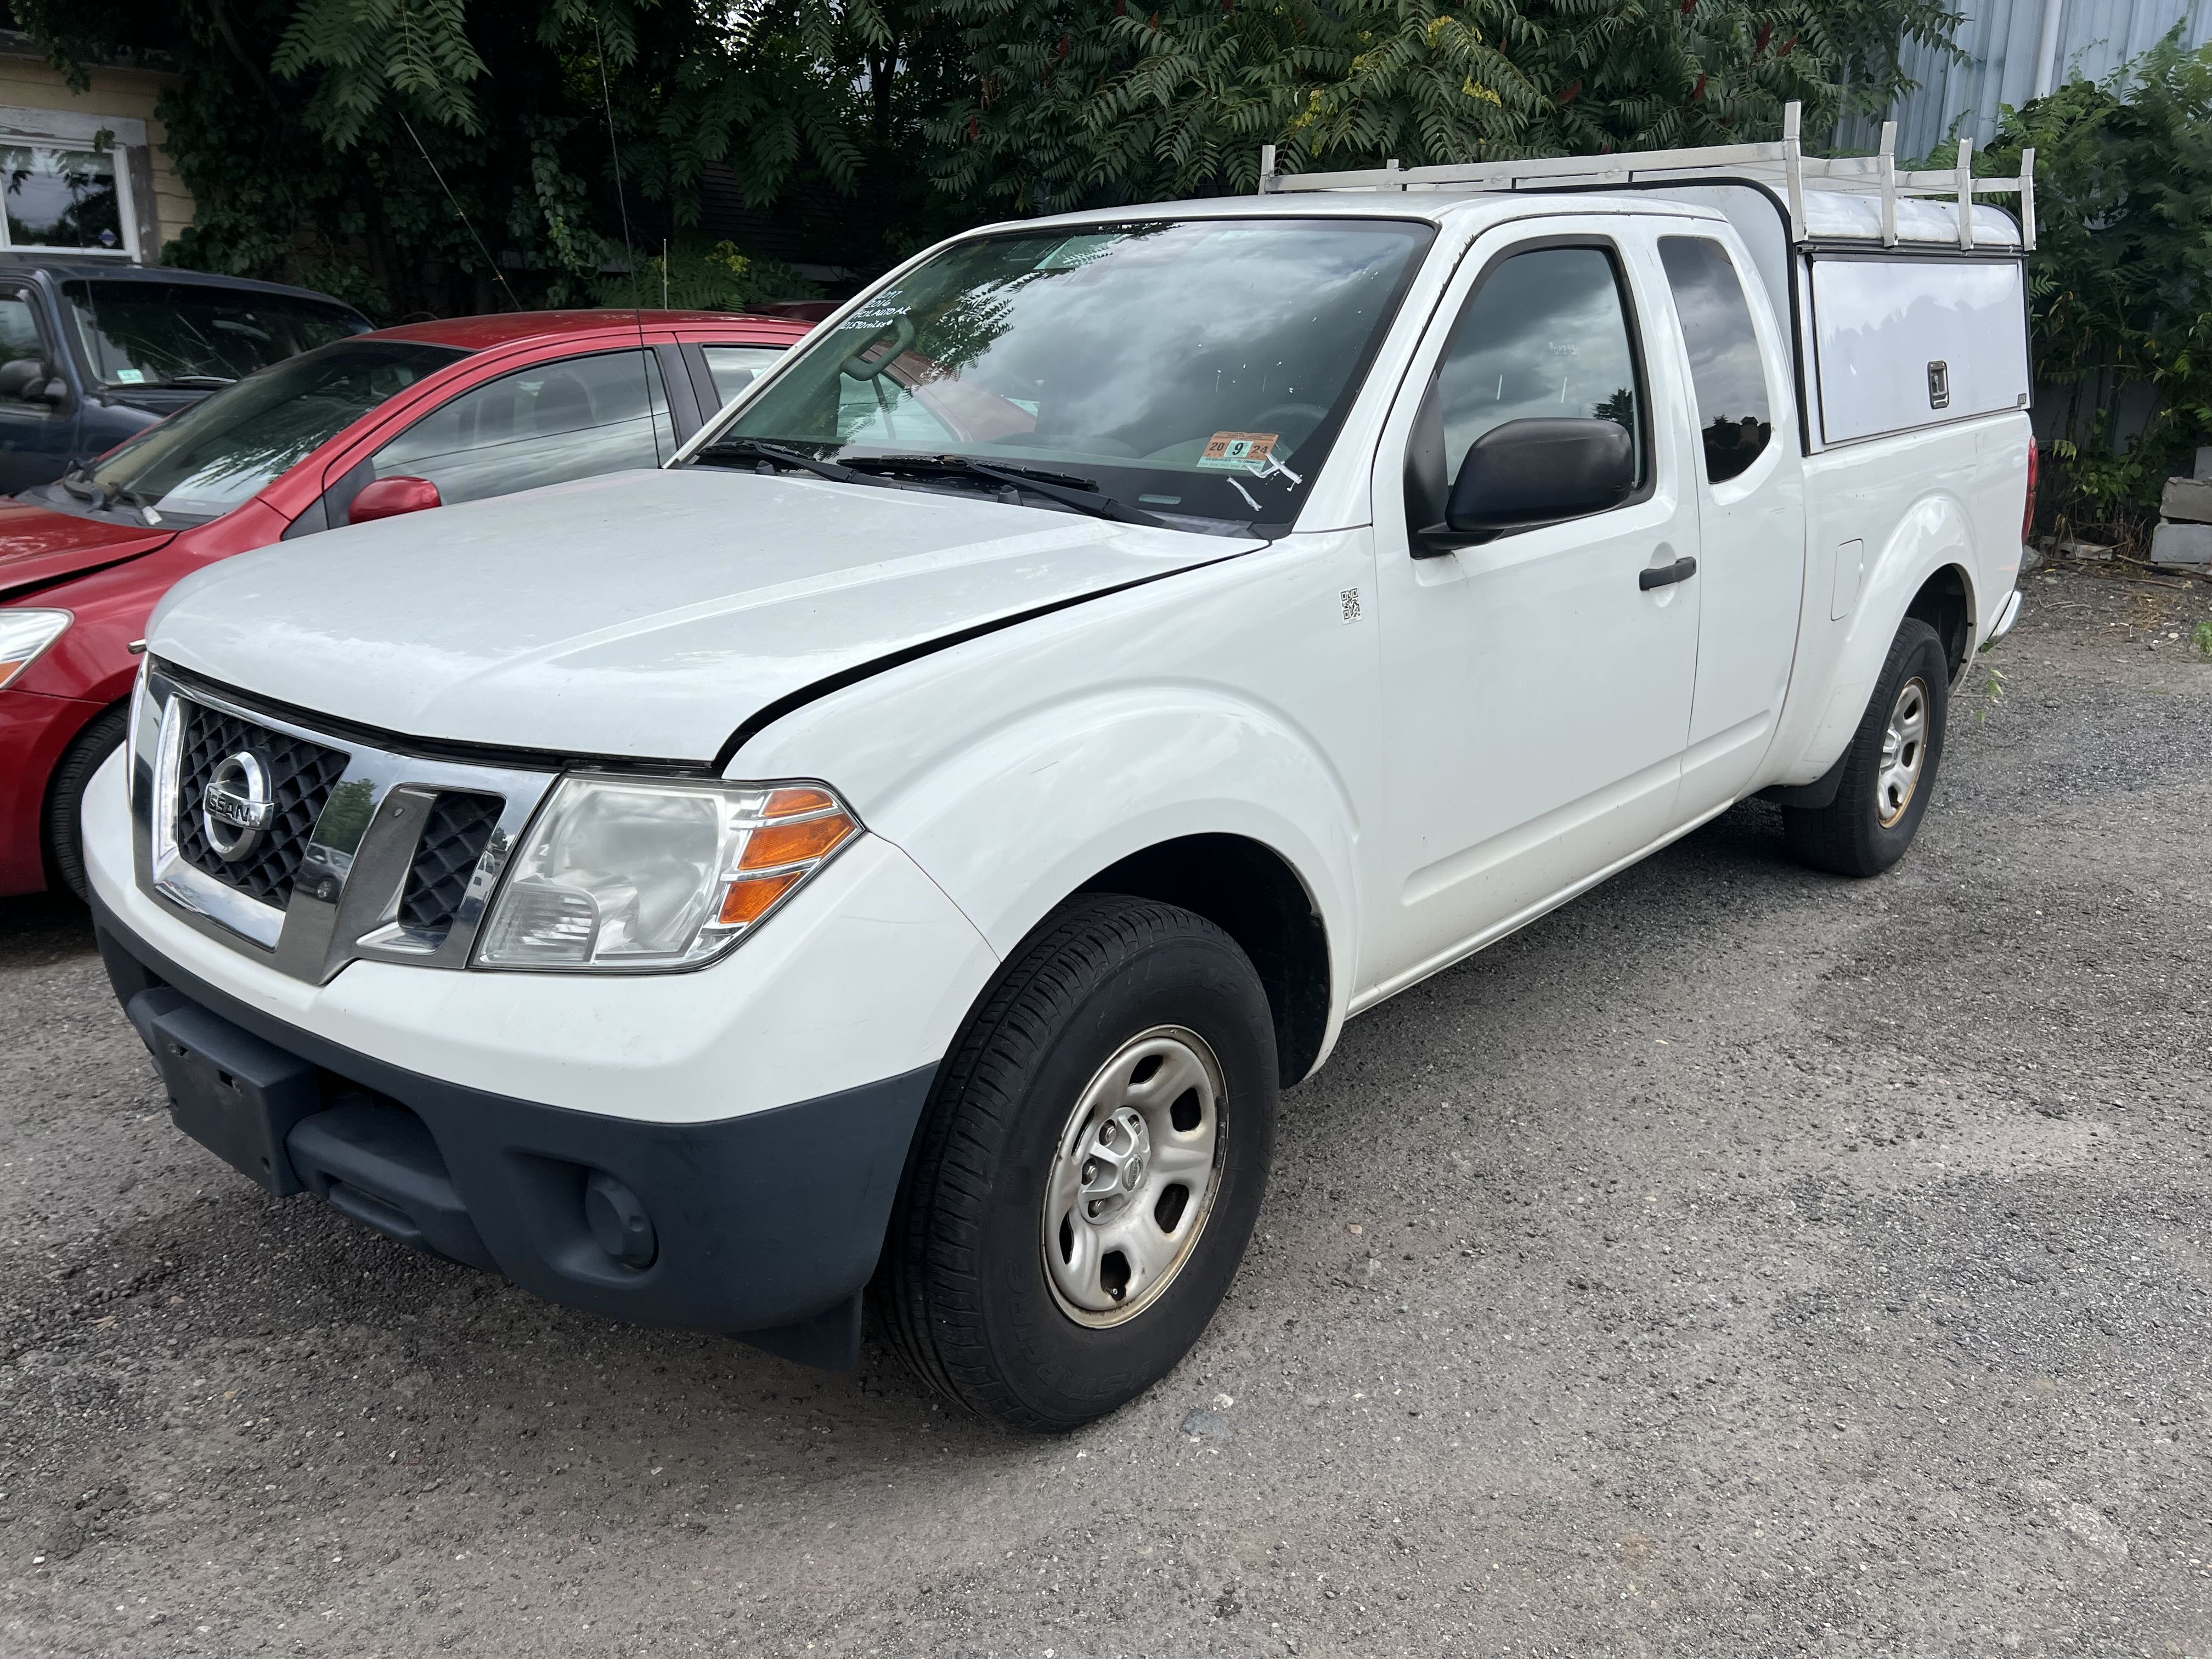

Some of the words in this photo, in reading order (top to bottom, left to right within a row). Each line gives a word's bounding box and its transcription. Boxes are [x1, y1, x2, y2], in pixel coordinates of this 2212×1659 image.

[864, 298, 891, 308] 2016
[870, 307, 895, 316] AUTO
[1210, 442, 1225, 451] 20
[1232, 442, 1244, 455] 9
[1251, 445, 1268, 454] 24
